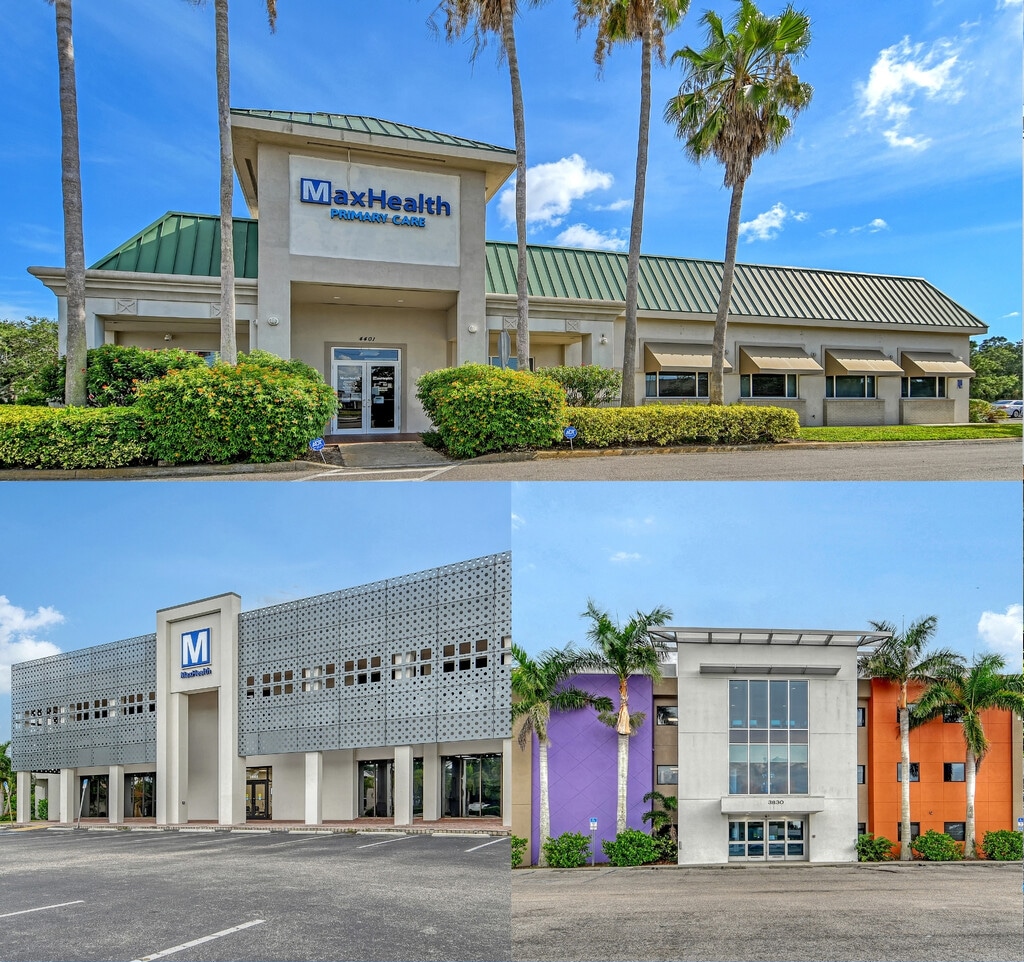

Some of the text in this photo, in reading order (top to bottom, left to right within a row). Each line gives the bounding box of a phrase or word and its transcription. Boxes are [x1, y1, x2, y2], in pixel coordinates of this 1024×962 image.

[301, 178, 451, 216] MaxHealth
[330, 208, 426, 227] PRIMARY CARE
[183, 631, 207, 665] M
[180, 667, 212, 679] MaxHealth
